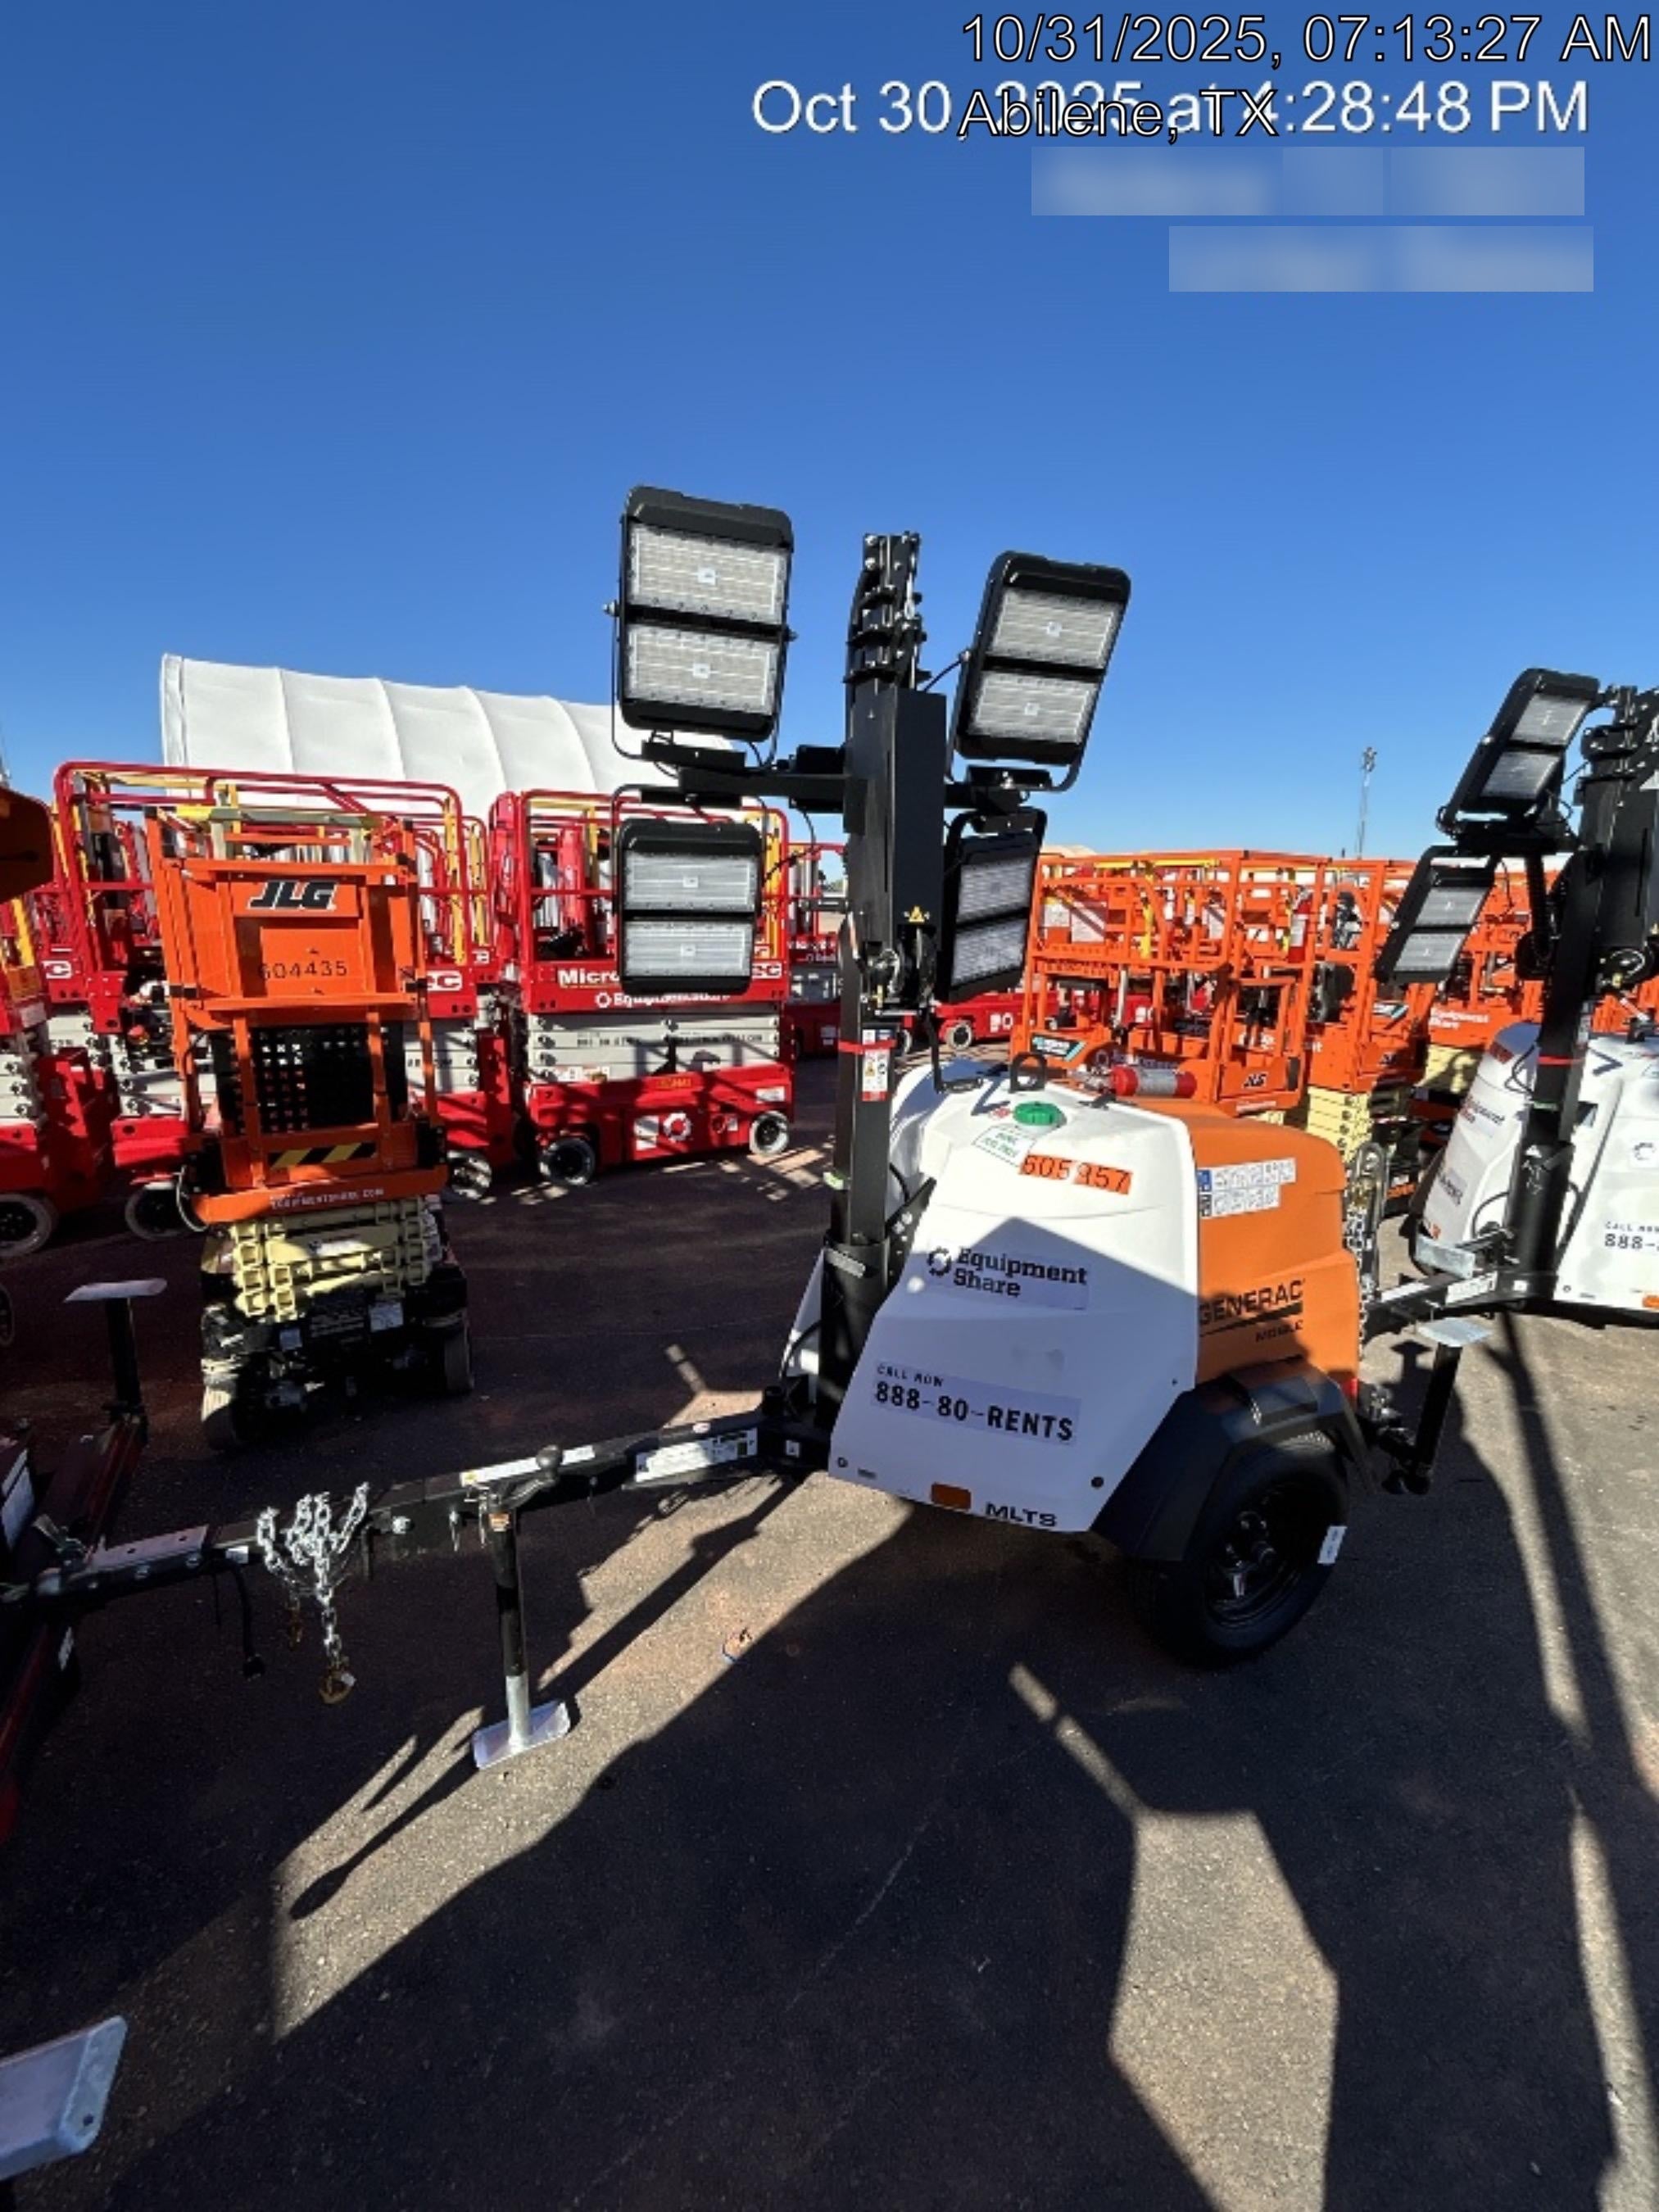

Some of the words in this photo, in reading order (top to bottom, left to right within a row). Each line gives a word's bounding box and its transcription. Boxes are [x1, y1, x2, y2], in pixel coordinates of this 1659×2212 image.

[247, 880, 337, 910] JLG
[1604, 1233, 1659, 1251] 888-
[958, 1247, 1088, 1285] Equipment
[953, 1268, 1022, 1298] Share
[1199, 1280, 1303, 1326] GENERAC
[877, 1363, 908, 1380] CALL
[913, 1373, 945, 1388] NOW
